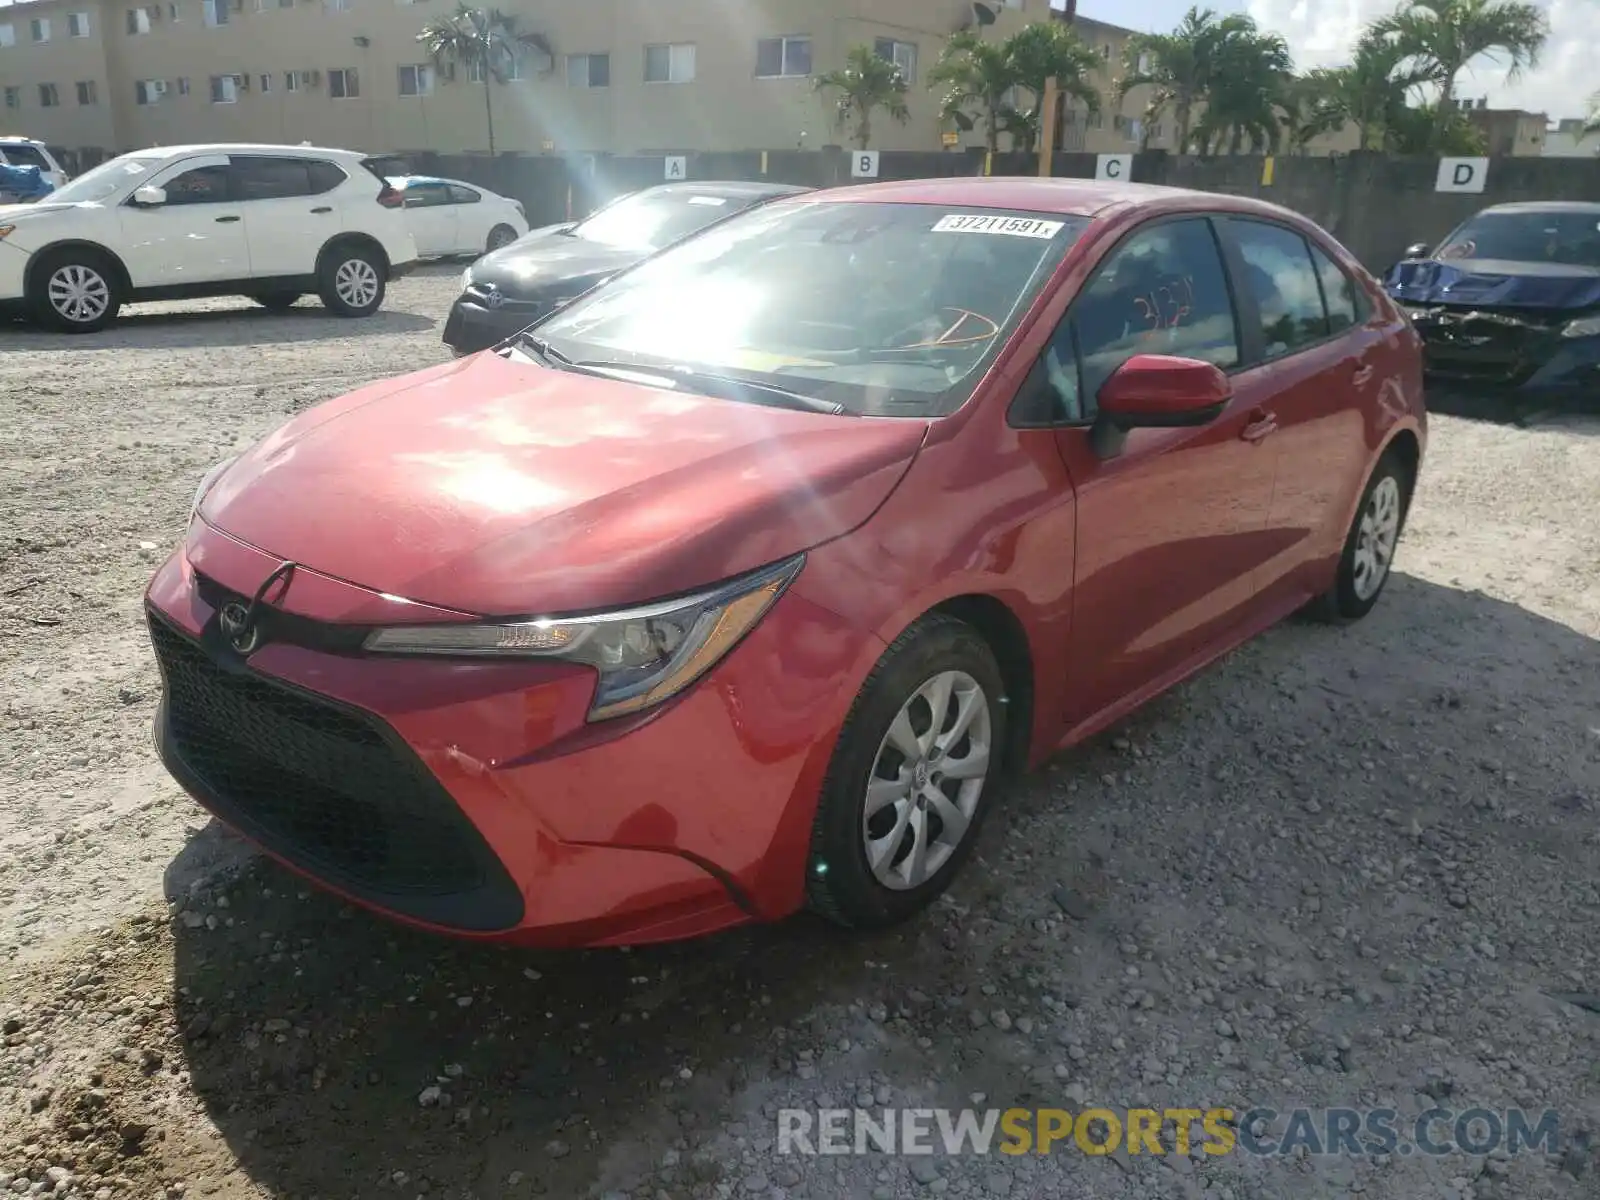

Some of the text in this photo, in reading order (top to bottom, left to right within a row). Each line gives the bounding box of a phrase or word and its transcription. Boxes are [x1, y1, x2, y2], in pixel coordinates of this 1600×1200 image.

[670, 160, 680, 176] A
[860, 155, 872, 172] B
[1105, 159, 1121, 178] C
[1452, 163, 1474, 186] D
